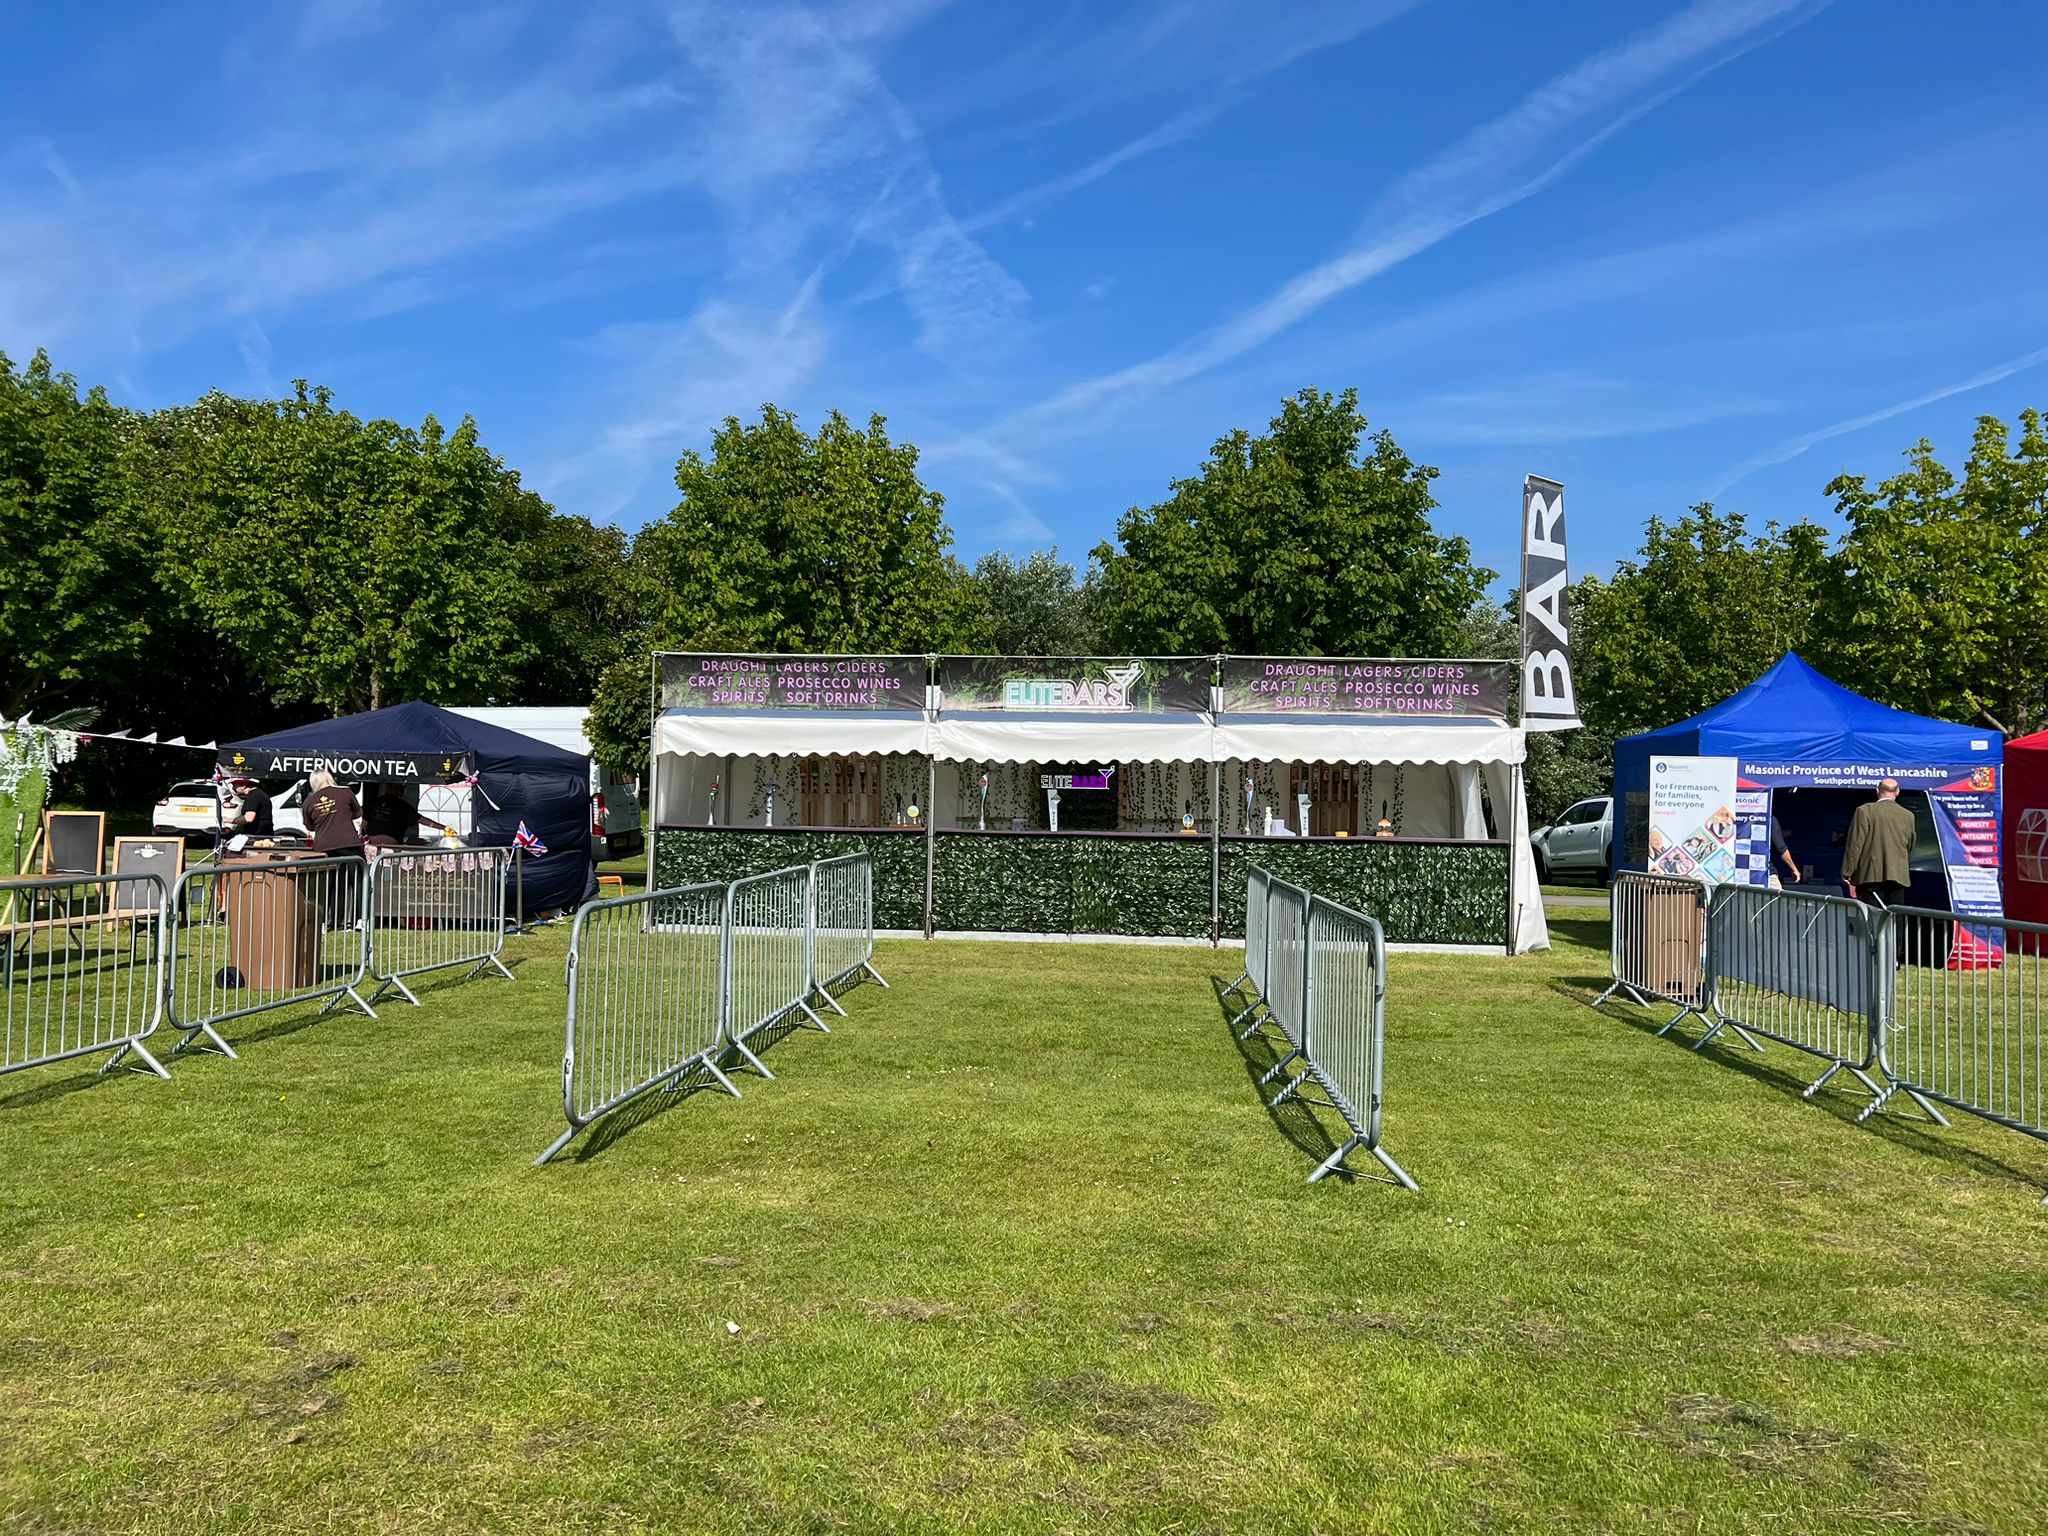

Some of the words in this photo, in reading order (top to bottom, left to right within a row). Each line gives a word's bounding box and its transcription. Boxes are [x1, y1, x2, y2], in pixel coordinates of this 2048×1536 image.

[1525, 491, 1576, 714] BAR
[701, 660, 767, 673] DRAUGHT
[775, 662, 829, 674] LAGERS
[837, 662, 886, 673] CIDERS
[1265, 664, 1337, 677] DRAUGHT
[1344, 666, 1401, 678] LAGERS
[1411, 667, 1465, 679] CIDERS
[688, 676, 733, 688] CRAFT
[738, 676, 771, 688] ALES
[778, 677, 850, 689] PROSECCO
[857, 678, 901, 689] WINES
[1250, 680, 1297, 693] CRAFT
[1302, 681, 1338, 693] ALES
[1345, 682, 1424, 695] PROSECCO
[1432, 683, 1479, 695] WINES
[712, 691, 765, 703] SPIRITS
[1275, 696, 1331, 709] SPIRITS
[270, 756, 380, 775] AFTERNOON
[384, 759, 419, 776] TEA
[1745, 764, 1791, 775] Masonic
[1792, 765, 1842, 775] Province
[1843, 765, 1856, 775] of
[1856, 765, 1885, 776] West
[1886, 767, 1948, 778] Lancashire
[1669, 783, 1720, 792] Freemasons,
[1813, 777, 1855, 786] Southport
[1655, 791, 1666, 799] for
[1668, 791, 1702, 800] families,
[1667, 801, 1705, 810] everyone
